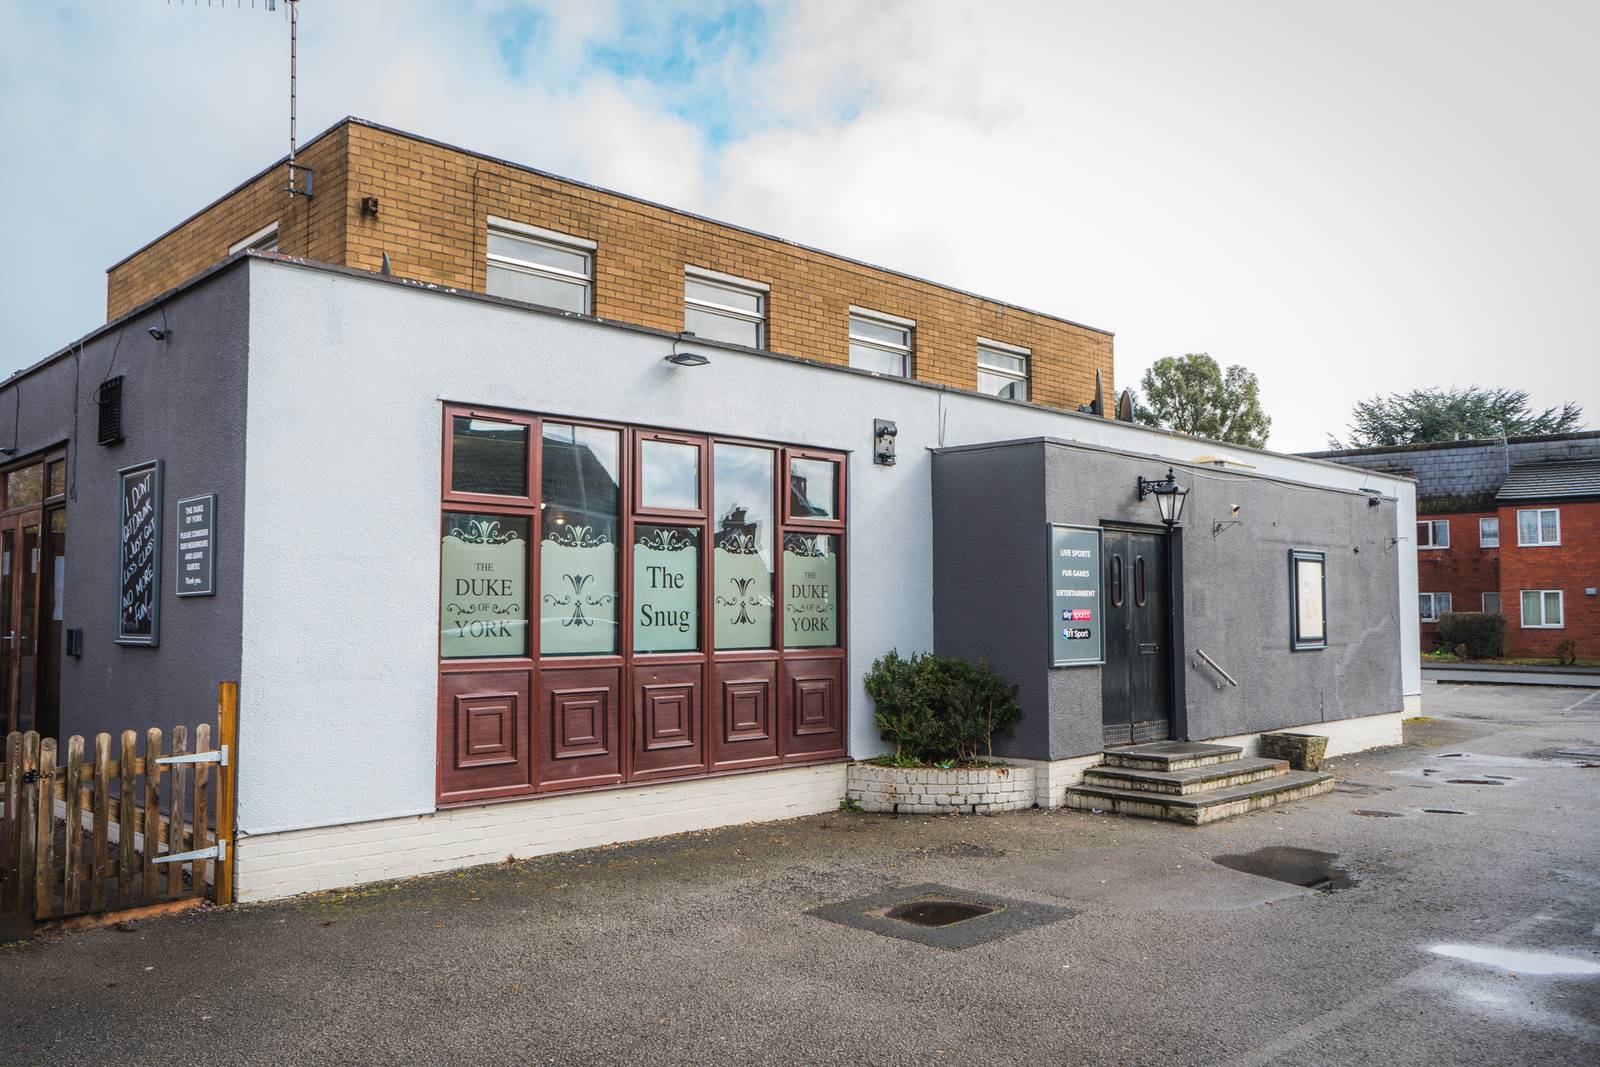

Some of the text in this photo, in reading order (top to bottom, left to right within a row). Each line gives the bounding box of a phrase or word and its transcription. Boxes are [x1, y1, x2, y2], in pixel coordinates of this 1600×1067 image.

[126, 496, 130, 517] I
[185, 504, 204, 515] THE DUKE
[186, 514, 203, 524] OF YORK
[180, 528, 209, 540] PLEASE CONSIDER
[125, 544, 129, 562] I
[129, 532, 143, 559] JUST
[180, 542, 188, 550] OUR
[185, 551, 203, 560] AND LEAVE
[1060, 548, 1091, 558] LIVE SPORTS
[475, 562, 494, 572] THE
[646, 566, 685, 589] The
[804, 571, 817, 580] THE
[1061, 569, 1090, 577] PUB GAMES
[135, 563, 154, 597] MORE
[455, 578, 513, 597] DUKE
[791, 584, 829, 599] DUKE
[1056, 589, 1096, 598] ENTERTAINMENT
[477, 602, 491, 612] OF
[806, 603, 814, 612] OF
[640, 603, 690, 633] Snug
[1063, 610, 1091, 620] sky sports
[455, 620, 513, 638] YORK
[791, 617, 829, 632] YORK
[1074, 629, 1089, 639] Sport
